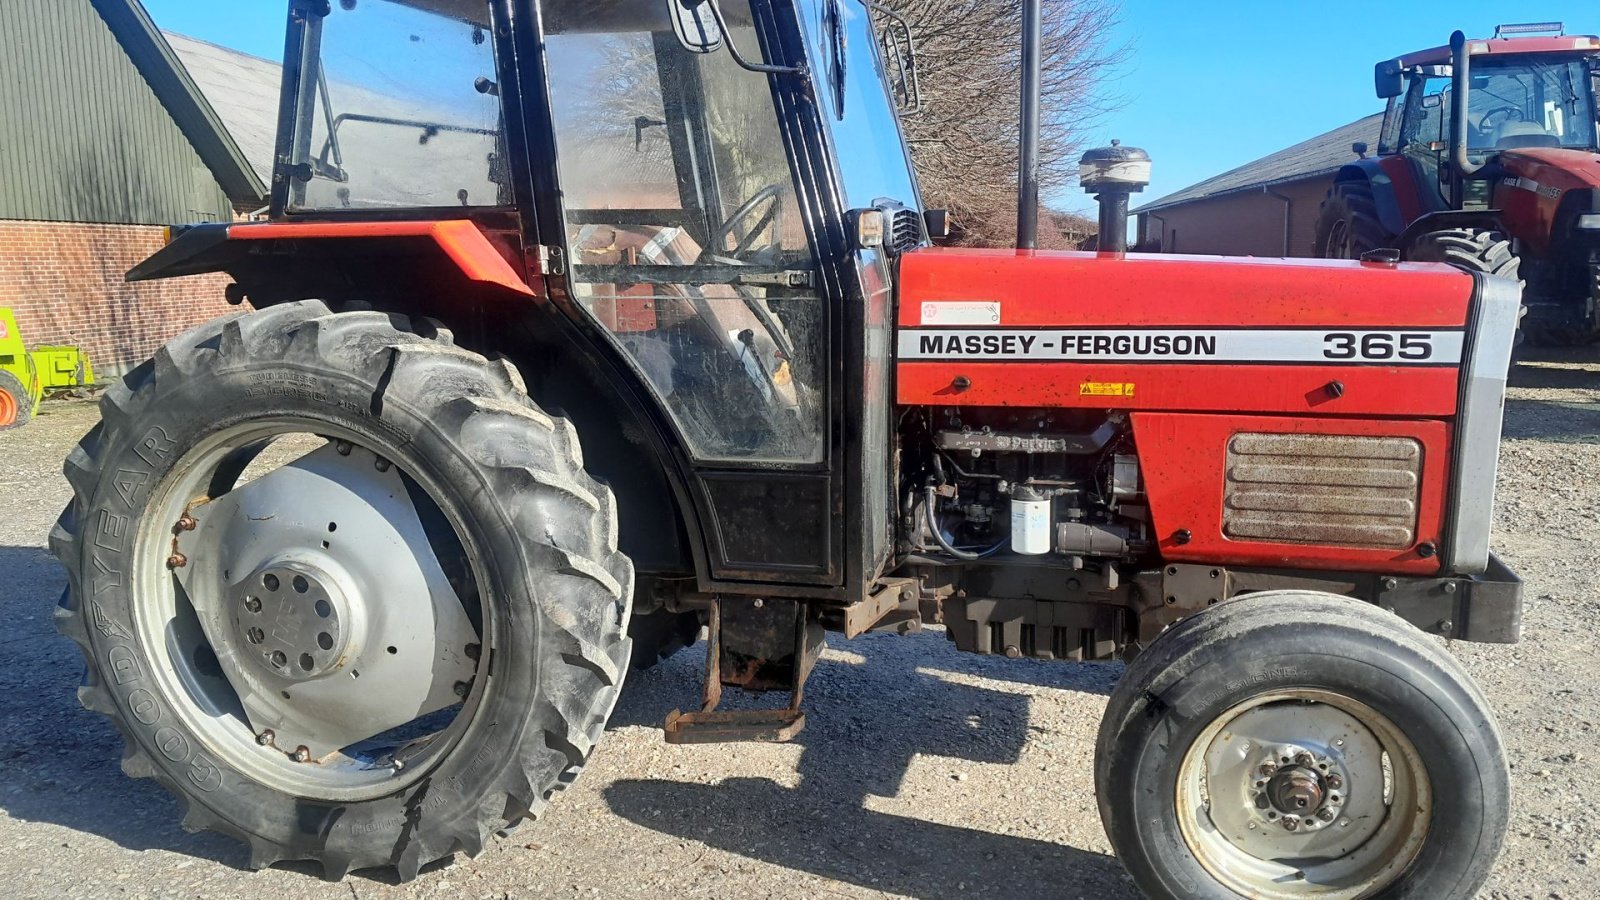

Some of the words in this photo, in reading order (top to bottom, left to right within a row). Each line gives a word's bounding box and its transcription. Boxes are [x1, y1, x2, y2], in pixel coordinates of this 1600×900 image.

[919, 335, 1036, 354] MASSEY
[1060, 335, 1216, 355] FERGUSON
[1323, 333, 1433, 360] 365
[91, 424, 223, 793] GOODYEAR
